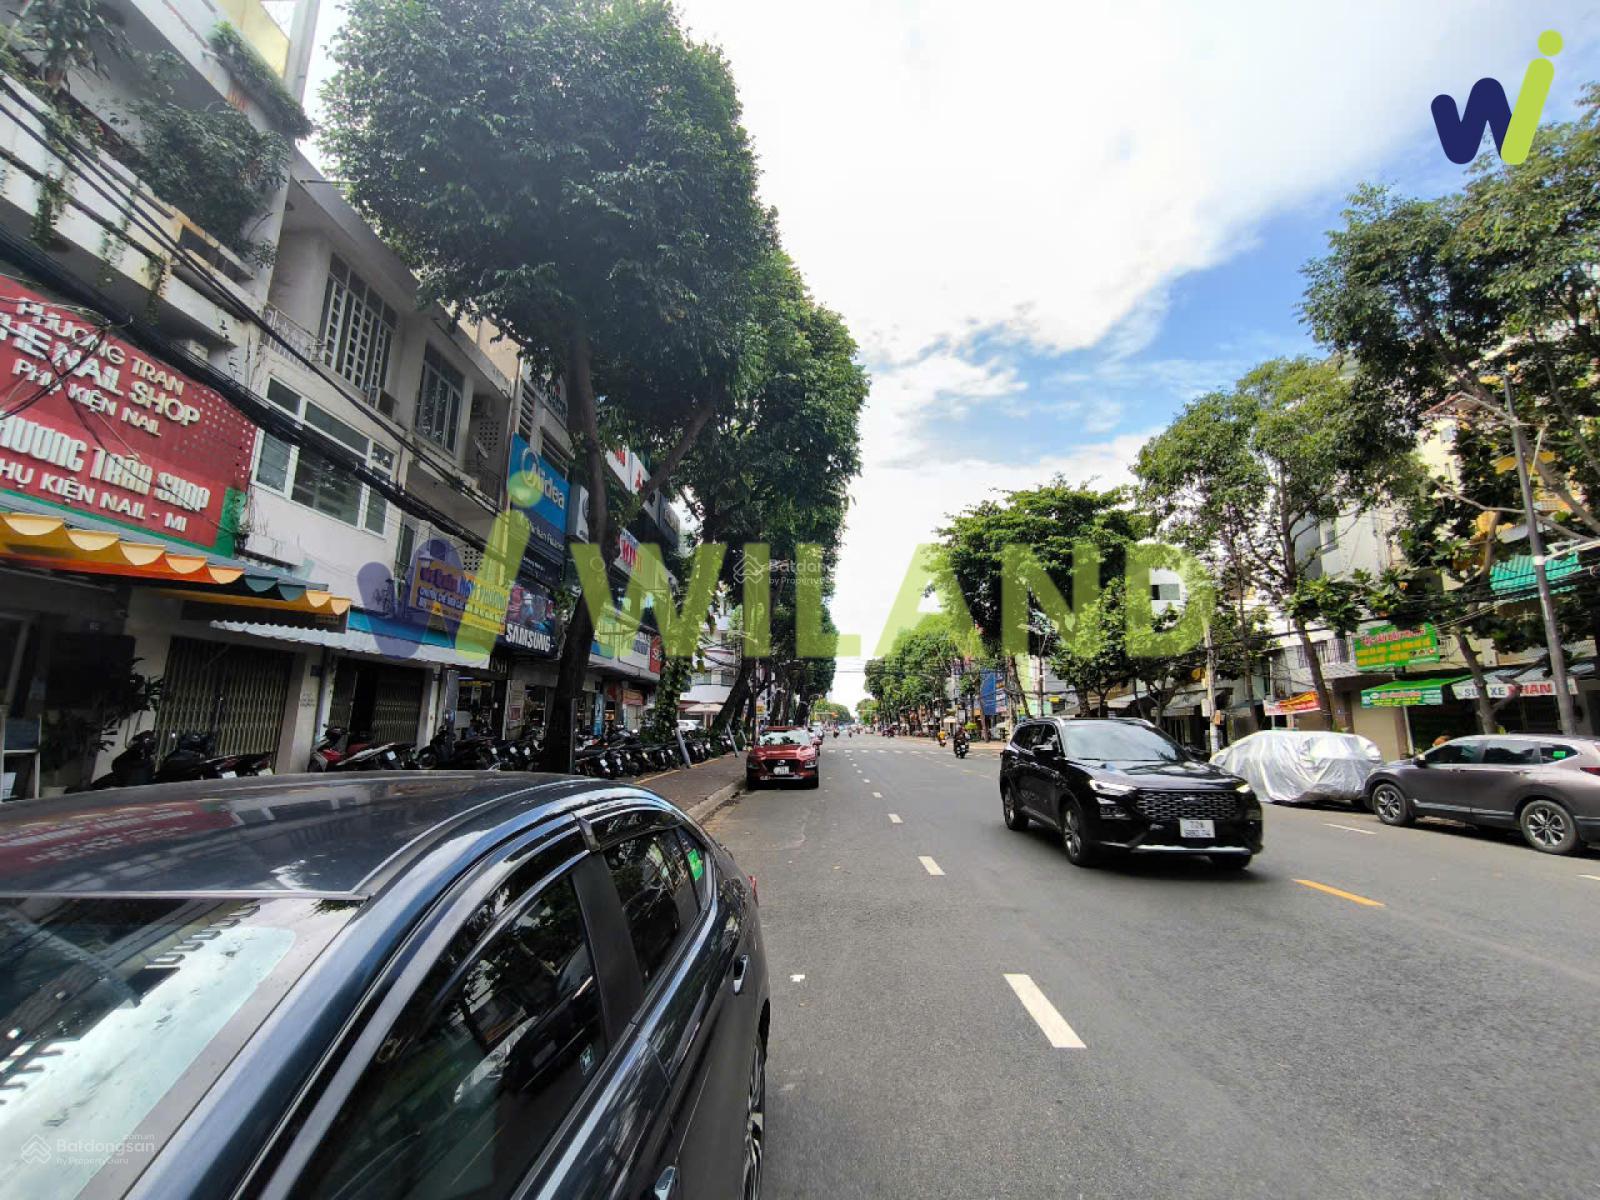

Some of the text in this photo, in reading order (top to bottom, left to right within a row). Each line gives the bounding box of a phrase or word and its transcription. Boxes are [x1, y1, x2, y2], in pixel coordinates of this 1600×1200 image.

[51, 341, 125, 396] NAIL
[129, 381, 201, 427] SHOP
[121, 407, 162, 437] NAIL
[99, 491, 146, 520] NAIL
[505, 623, 551, 652] SAMSUNG
